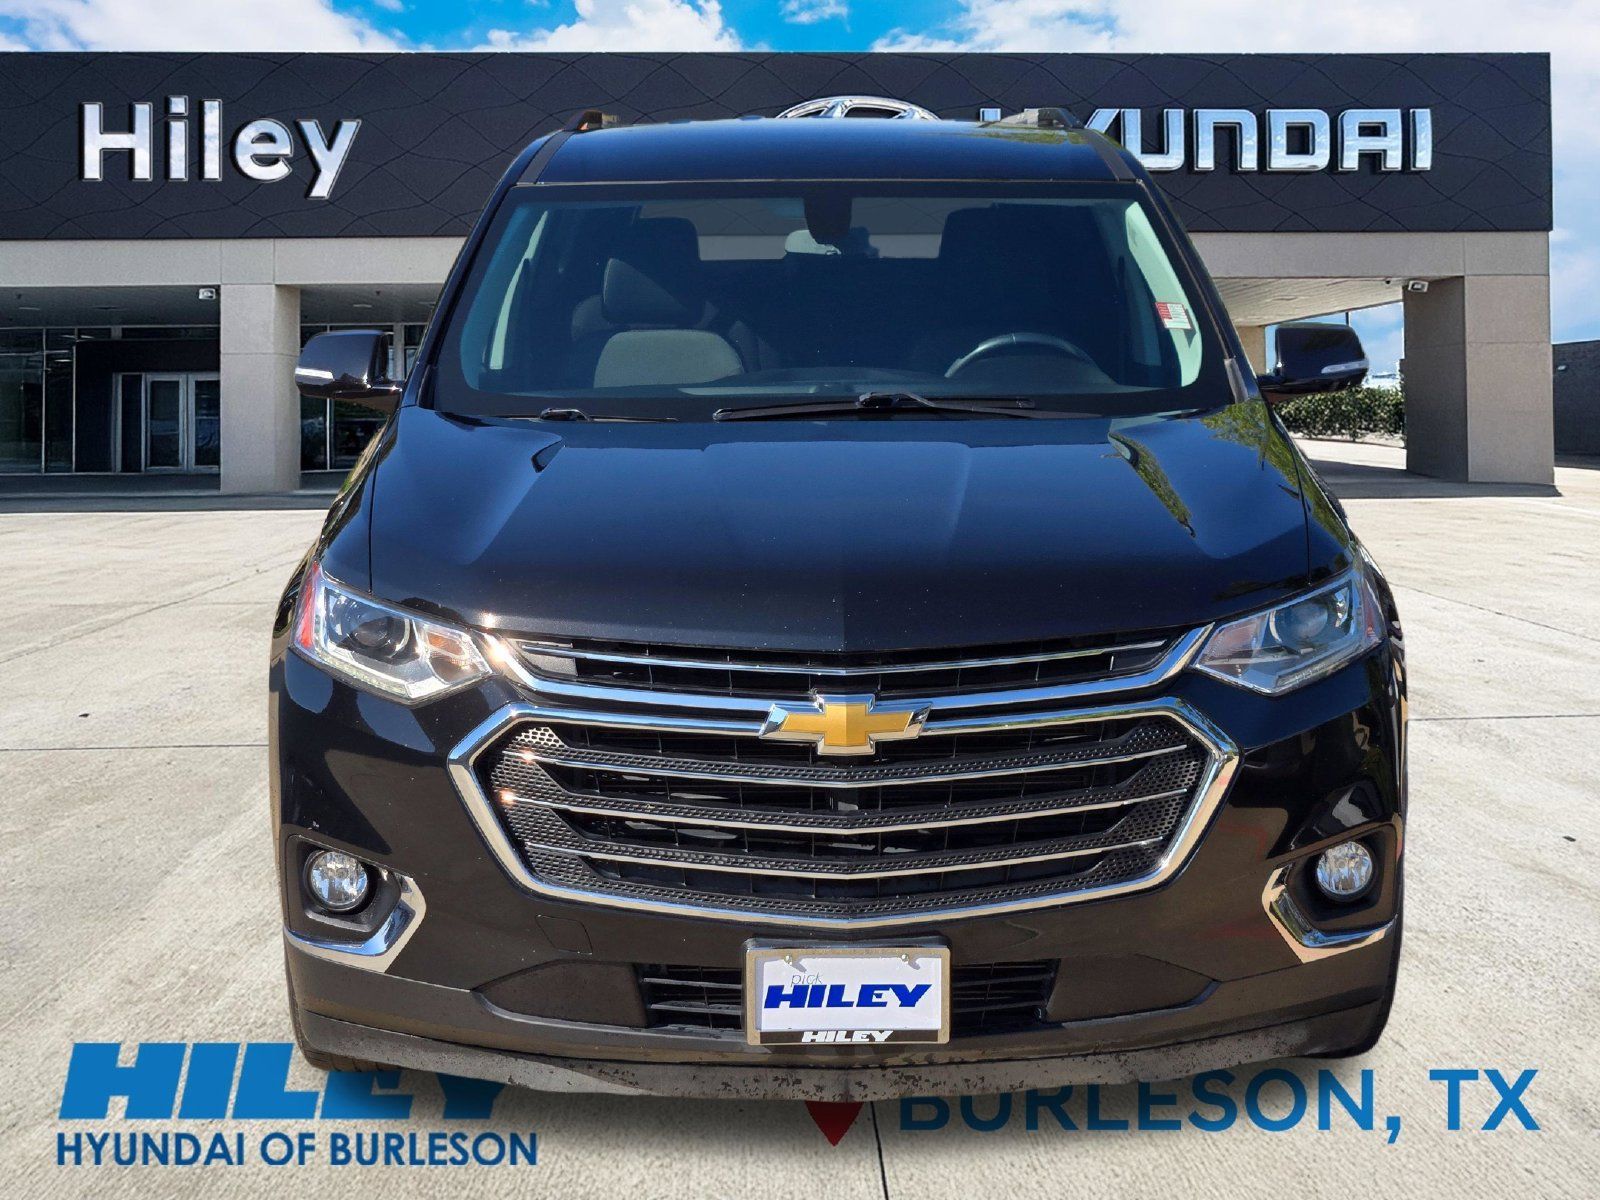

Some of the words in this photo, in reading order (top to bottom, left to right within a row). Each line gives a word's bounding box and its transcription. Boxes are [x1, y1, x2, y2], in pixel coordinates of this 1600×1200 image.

[82, 95, 362, 199] Hiley
[979, 107, 1433, 172] UNDAI
[763, 984, 932, 1009] HILEY
[801, 1030, 894, 1043] HILEY
